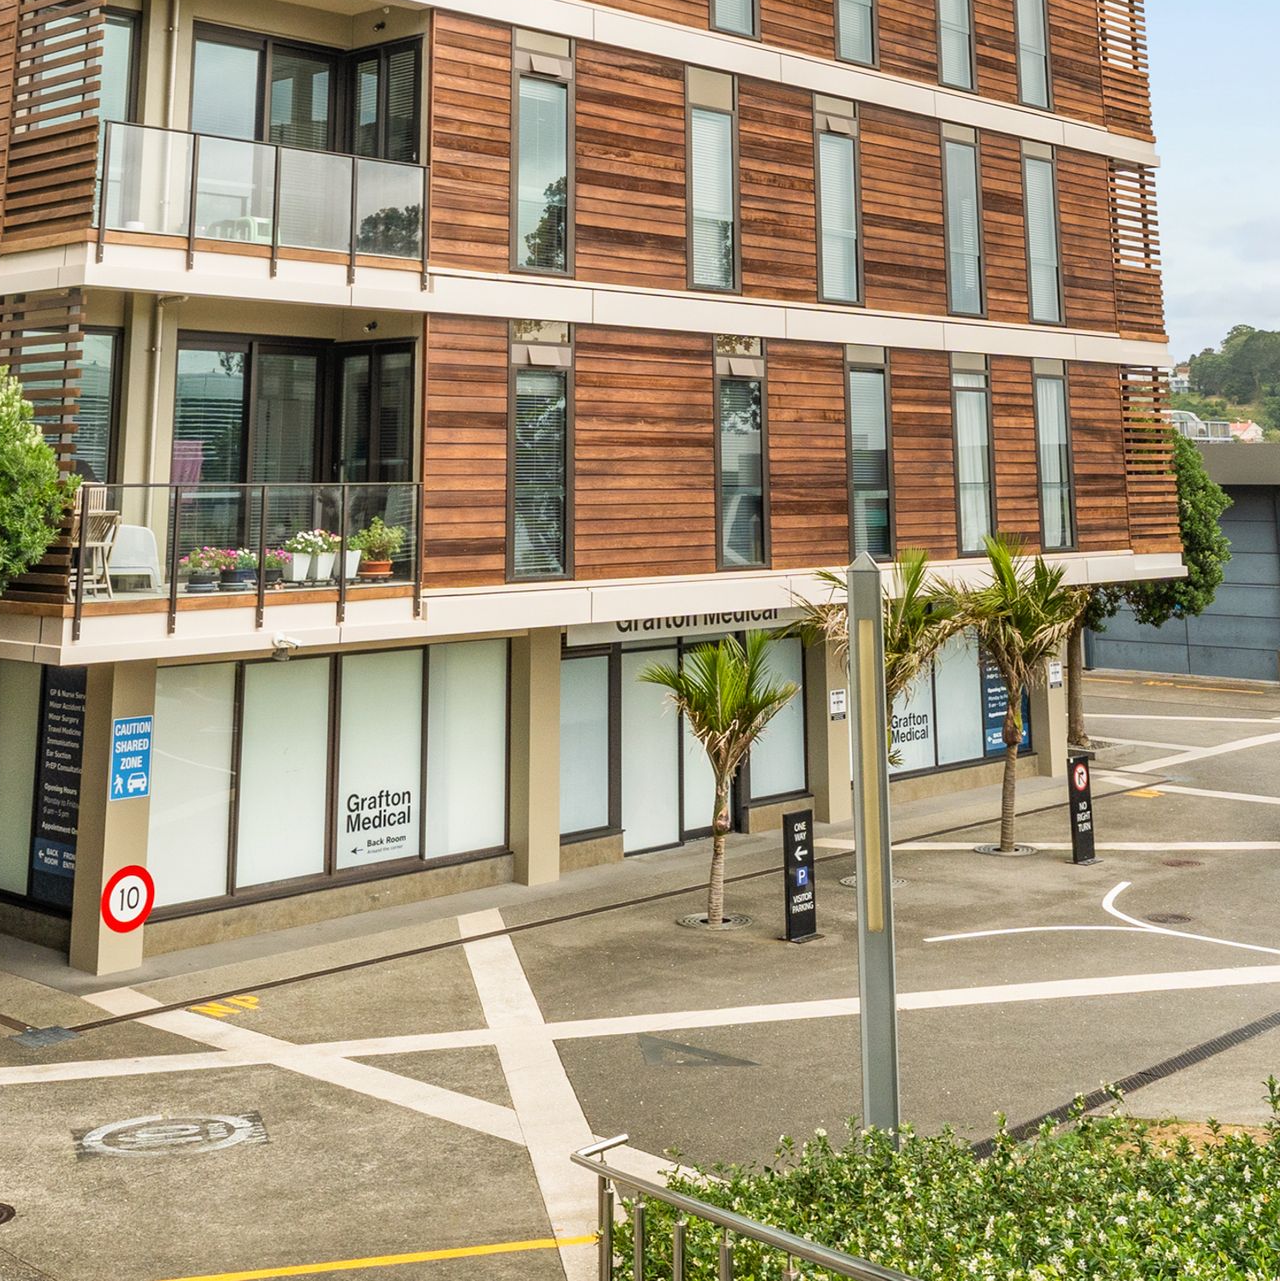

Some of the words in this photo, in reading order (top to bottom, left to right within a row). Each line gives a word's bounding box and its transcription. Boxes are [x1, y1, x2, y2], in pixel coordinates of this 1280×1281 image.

[892, 713, 928, 729] Grafton
[115, 721, 151, 736] CAUTION
[892, 726, 928, 744] Medical
[115, 739, 149, 753] SHARED
[120, 756, 143, 770] ZONE
[347, 790, 411, 813] Grafton
[1079, 801, 1087, 811] NO
[346, 805, 411, 833] Medical
[1077, 811, 1090, 822] RIGHT
[794, 822, 806, 831] ONE
[1078, 822, 1091, 832] TURN
[367, 838, 384, 847] Back
[386, 835, 406, 844] Room
[794, 832, 806, 841] WAY
[799, 870, 805, 883] P
[120, 886, 140, 911] 10
[793, 891, 812, 903] VISITOR
[792, 901, 814, 914] PARKING
